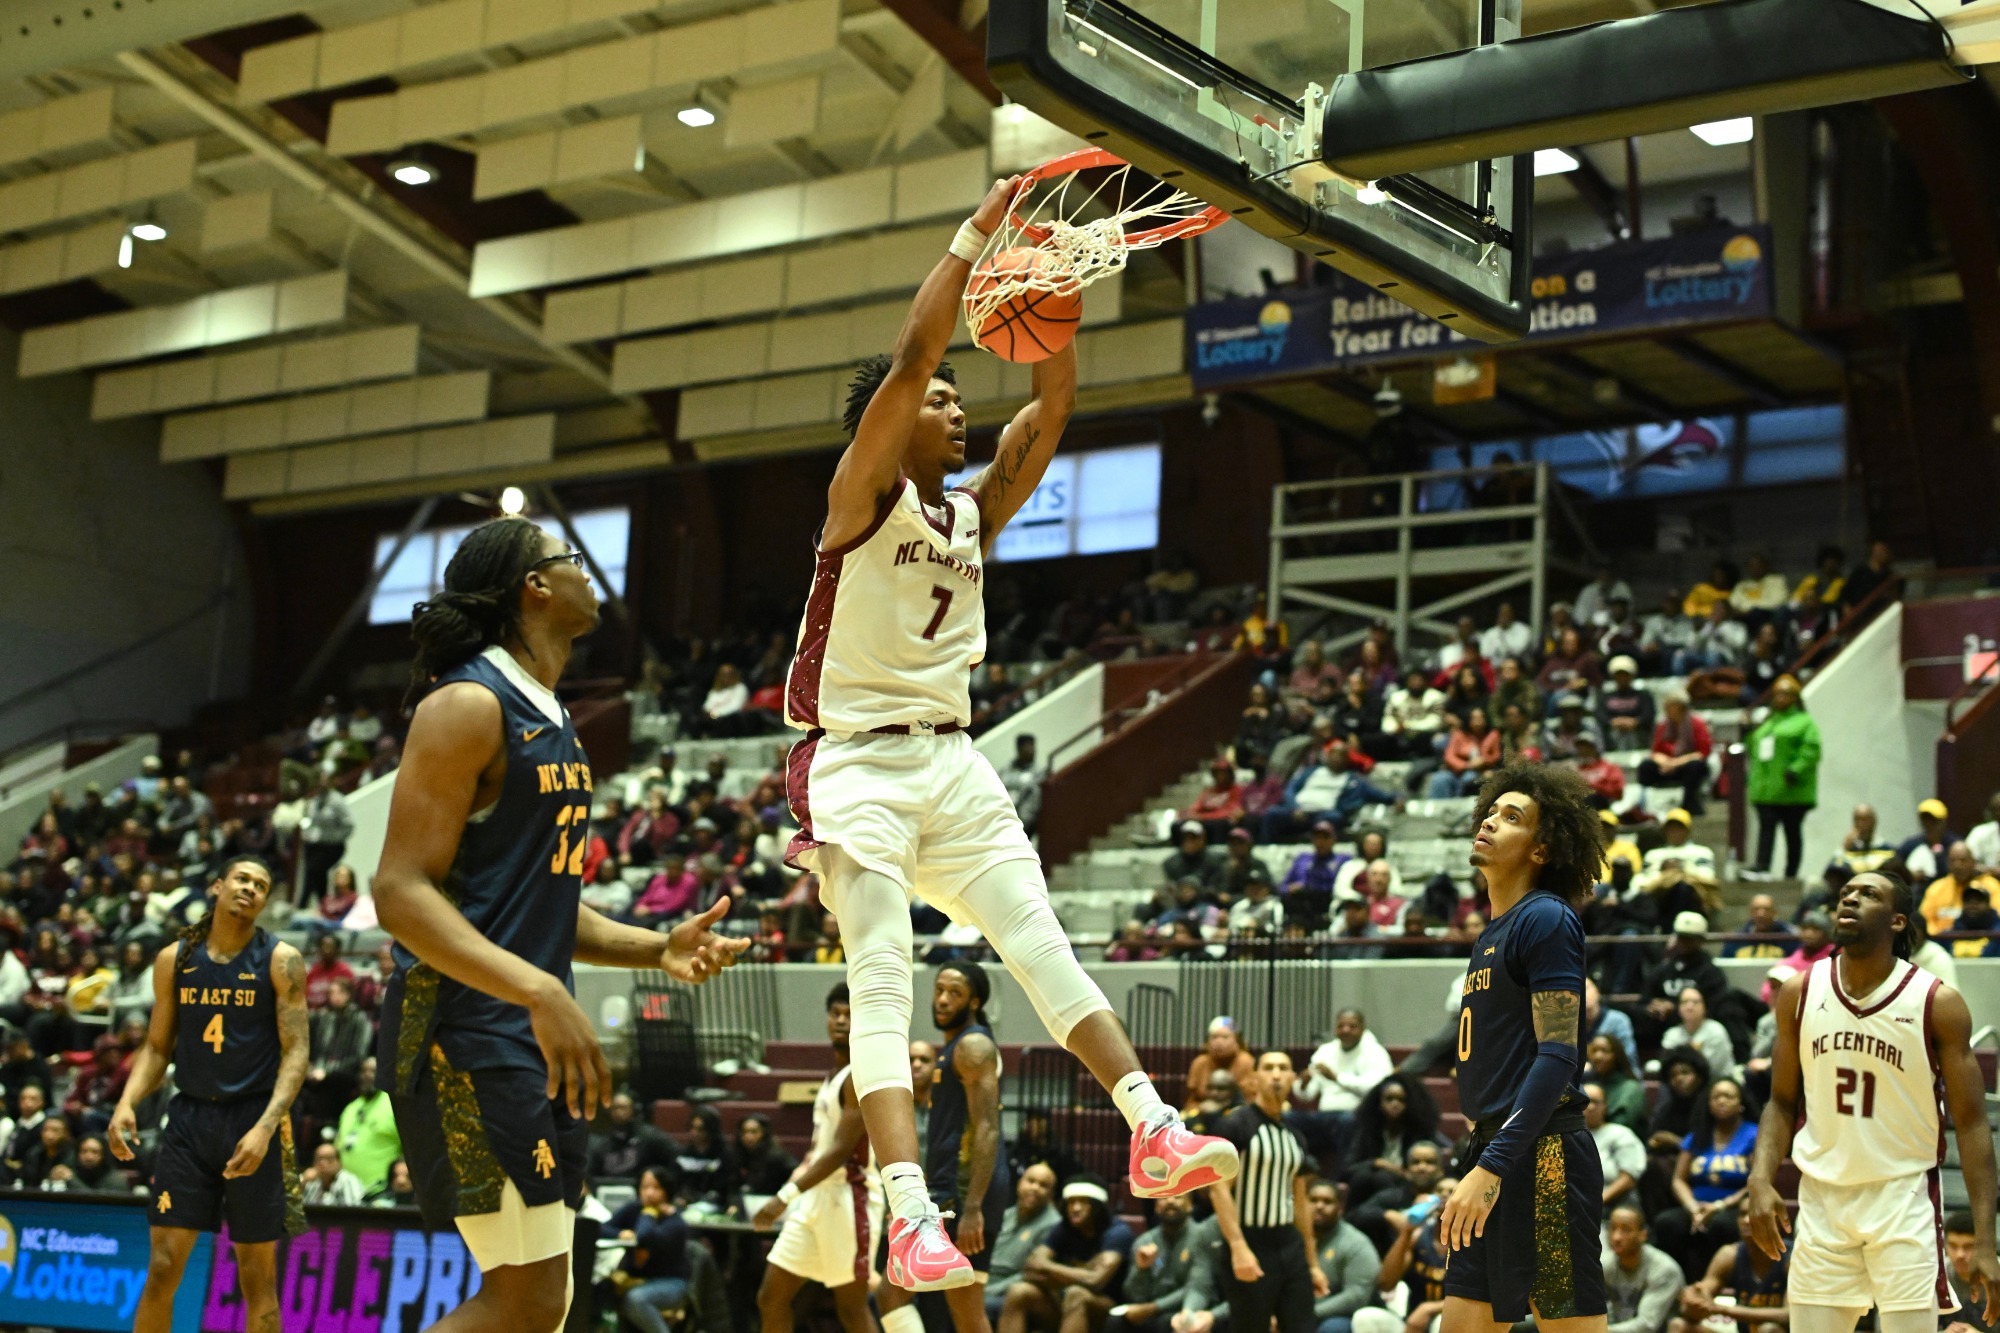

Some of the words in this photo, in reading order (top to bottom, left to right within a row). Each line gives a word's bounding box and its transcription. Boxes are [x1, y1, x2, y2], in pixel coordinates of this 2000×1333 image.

[1575, 270, 1597, 292] a
[1197, 337, 1287, 368] Lottery
[1331, 328, 1394, 357] Year
[1400, 321, 1443, 347] for
[894, 539, 924, 566] NC
[922, 584, 955, 642] 7
[536, 763, 563, 794] NC
[551, 804, 588, 876] 32
[1475, 967, 1492, 991] SU
[180, 987, 198, 1005] NC
[200, 988, 232, 1006] A&T
[234, 989, 256, 1007] SU
[202, 1013, 225, 1055] 4
[1812, 1034, 1829, 1060] NC
[1833, 1031, 1905, 1073] CENTRAL
[1836, 1066, 1877, 1120] 21
[20, 1227, 46, 1251] NC
[46, 1228, 119, 1255] Education
[12, 1251, 149, 1320] Lottery
